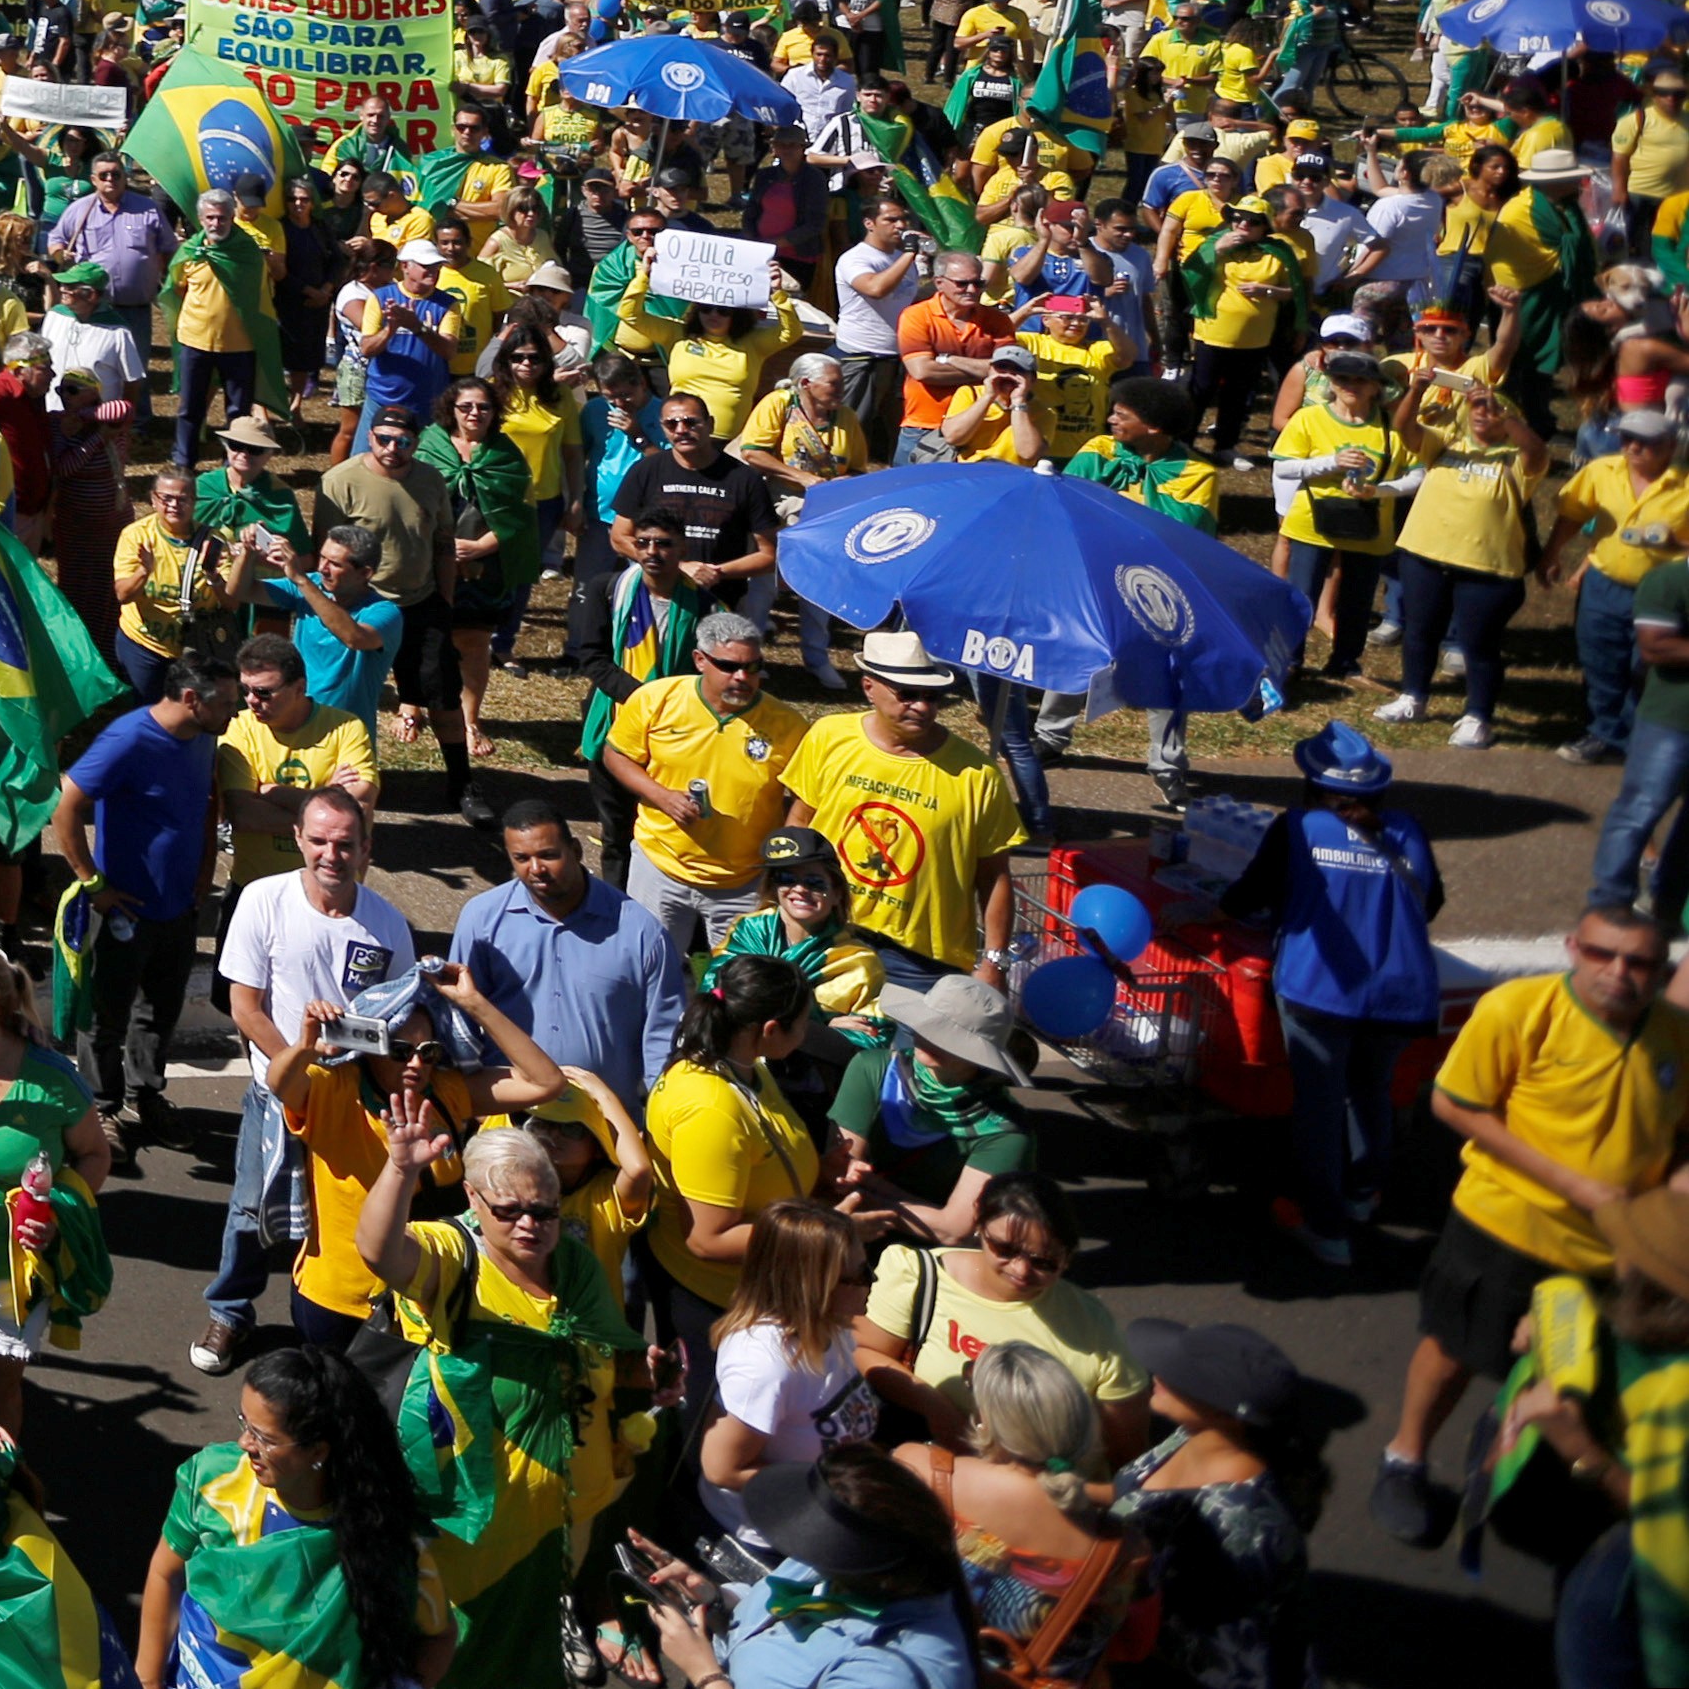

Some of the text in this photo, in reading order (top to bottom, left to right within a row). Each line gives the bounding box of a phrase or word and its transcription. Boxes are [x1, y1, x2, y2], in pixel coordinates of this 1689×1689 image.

[690, 0, 714, 10] DO
[232, 10, 405, 48] SÃO PARA
[217, 37, 436, 76] EQUILIBRAR,
[314, 78, 440, 114] PARA
[668, 234, 681, 260] O
[672, 278, 735, 305] BABACA
[845, 774, 923, 806] IMPEACHMENT
